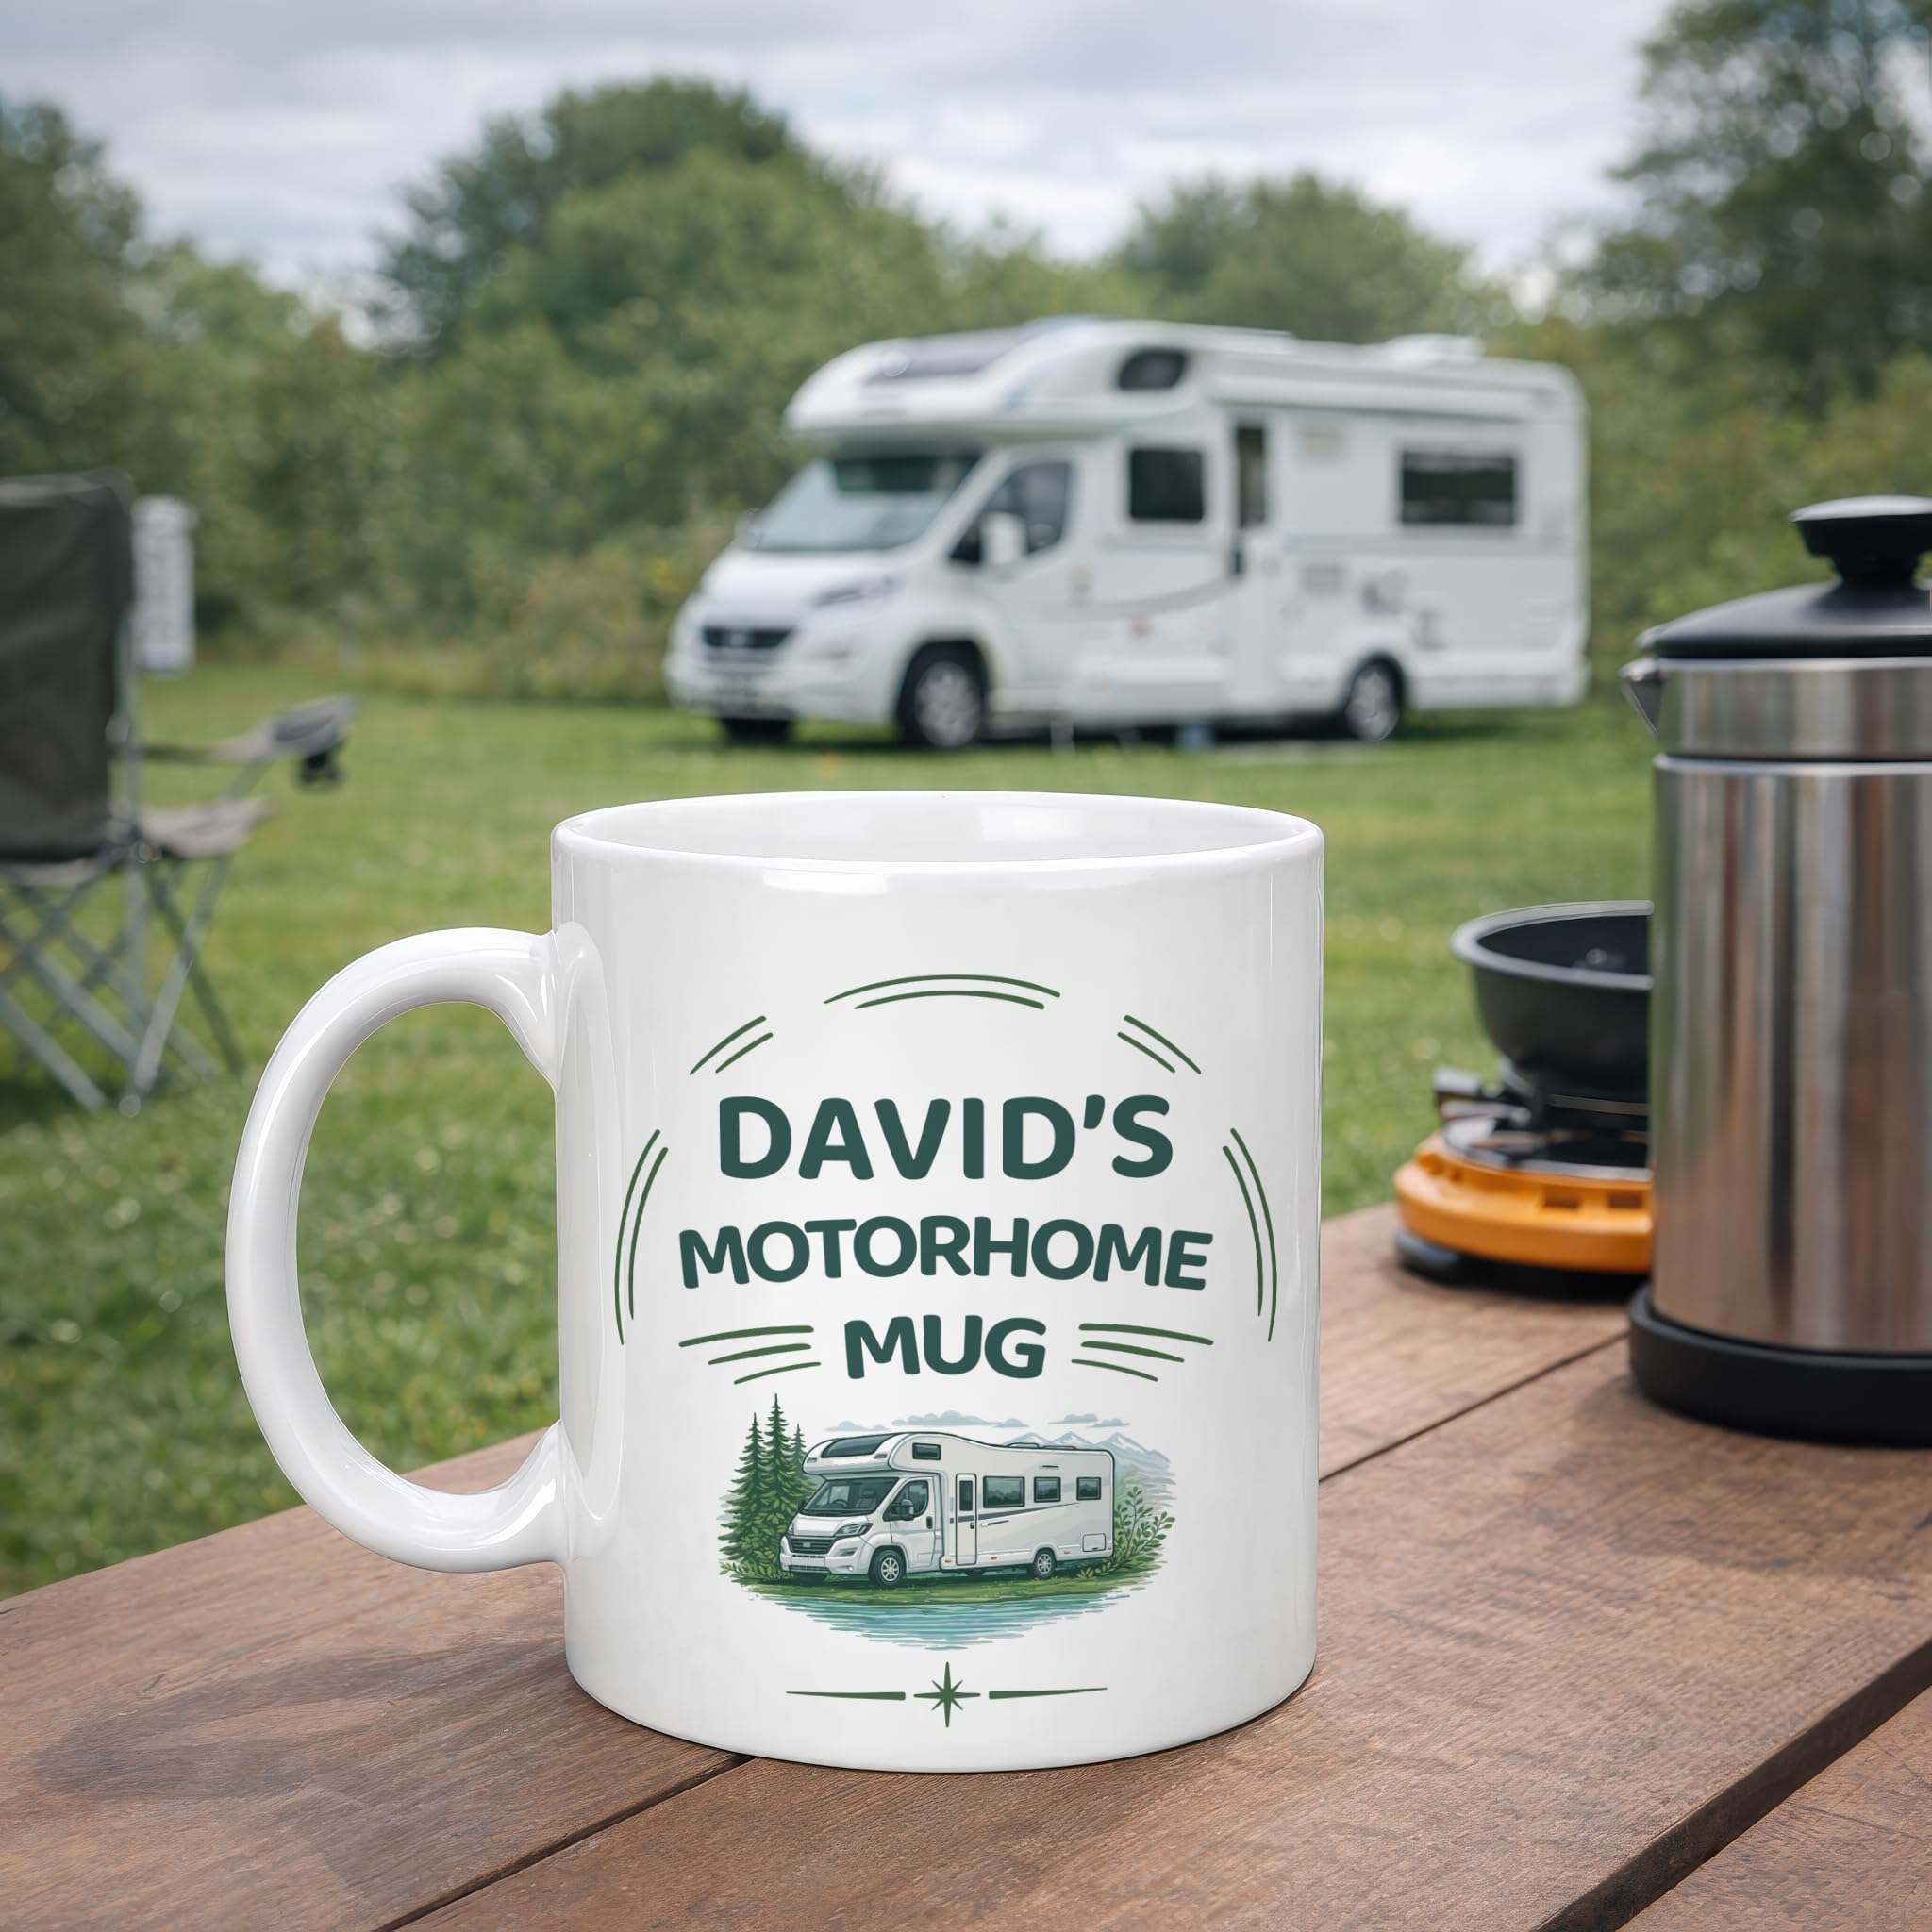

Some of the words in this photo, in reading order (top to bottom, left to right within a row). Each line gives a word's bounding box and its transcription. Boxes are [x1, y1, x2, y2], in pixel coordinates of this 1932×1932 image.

[720, 1095, 1174, 1180] DAVID'S
[679, 1216, 1214, 1290] MOTORHOME
[845, 1315, 1047, 1379] MUG
